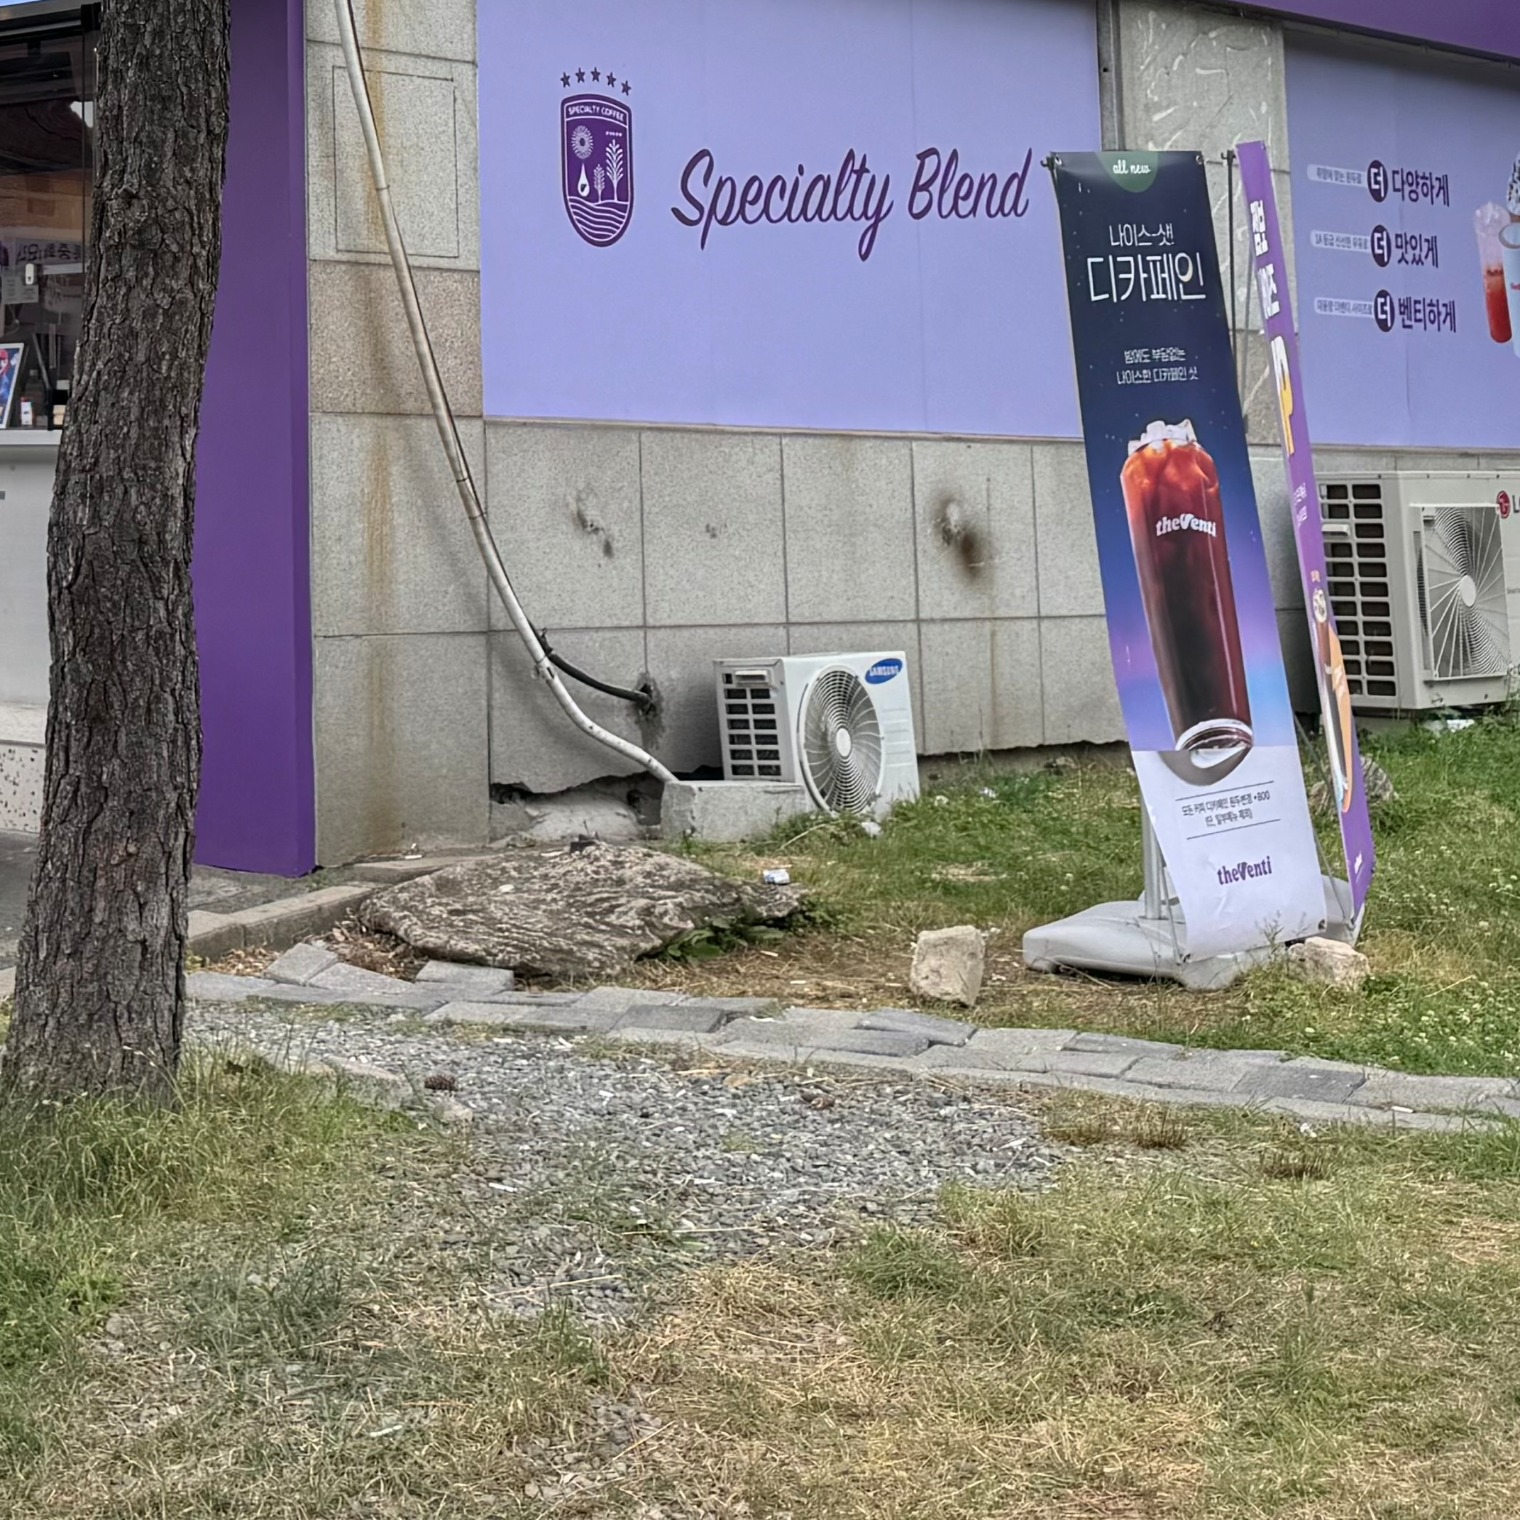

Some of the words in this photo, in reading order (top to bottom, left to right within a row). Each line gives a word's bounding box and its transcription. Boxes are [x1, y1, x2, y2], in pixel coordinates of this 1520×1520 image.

[1113, 160, 1128, 174] all
[1130, 162, 1151, 174] new
[1391, 167, 1450, 207] 다양하게
[671, 148, 893, 262] Specialty
[907, 147, 1033, 220] Blend
[1395, 232, 1439, 269] 맛있게
[1087, 251, 1207, 303] 디카페인
[1398, 296, 1457, 333] 벤티하게
[1152, 346, 1187, 362] 부담없는
[1117, 368, 1151, 385] 나이스한
[1153, 367, 1187, 383] 디카페인
[1156, 513, 1217, 538] theVenti
[868, 665, 900, 678] SAMSUNG
[1217, 855, 1273, 885] theVenti
